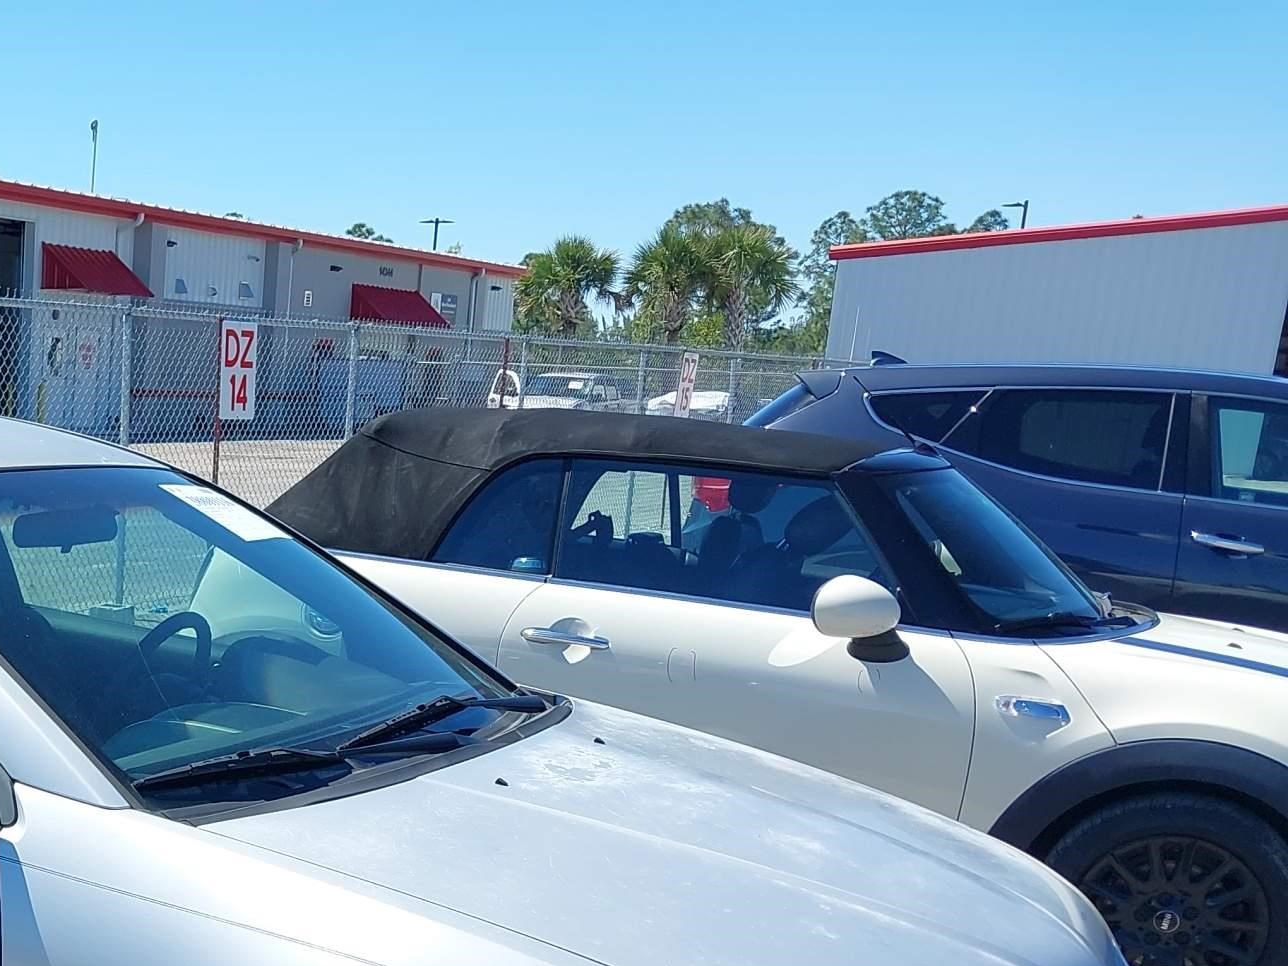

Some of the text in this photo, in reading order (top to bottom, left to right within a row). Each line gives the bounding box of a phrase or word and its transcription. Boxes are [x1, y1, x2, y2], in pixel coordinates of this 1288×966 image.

[224, 328, 255, 369] DZ
[682, 358, 697, 383] DZ
[229, 374, 248, 412] 14
[680, 387, 690, 411] 15
